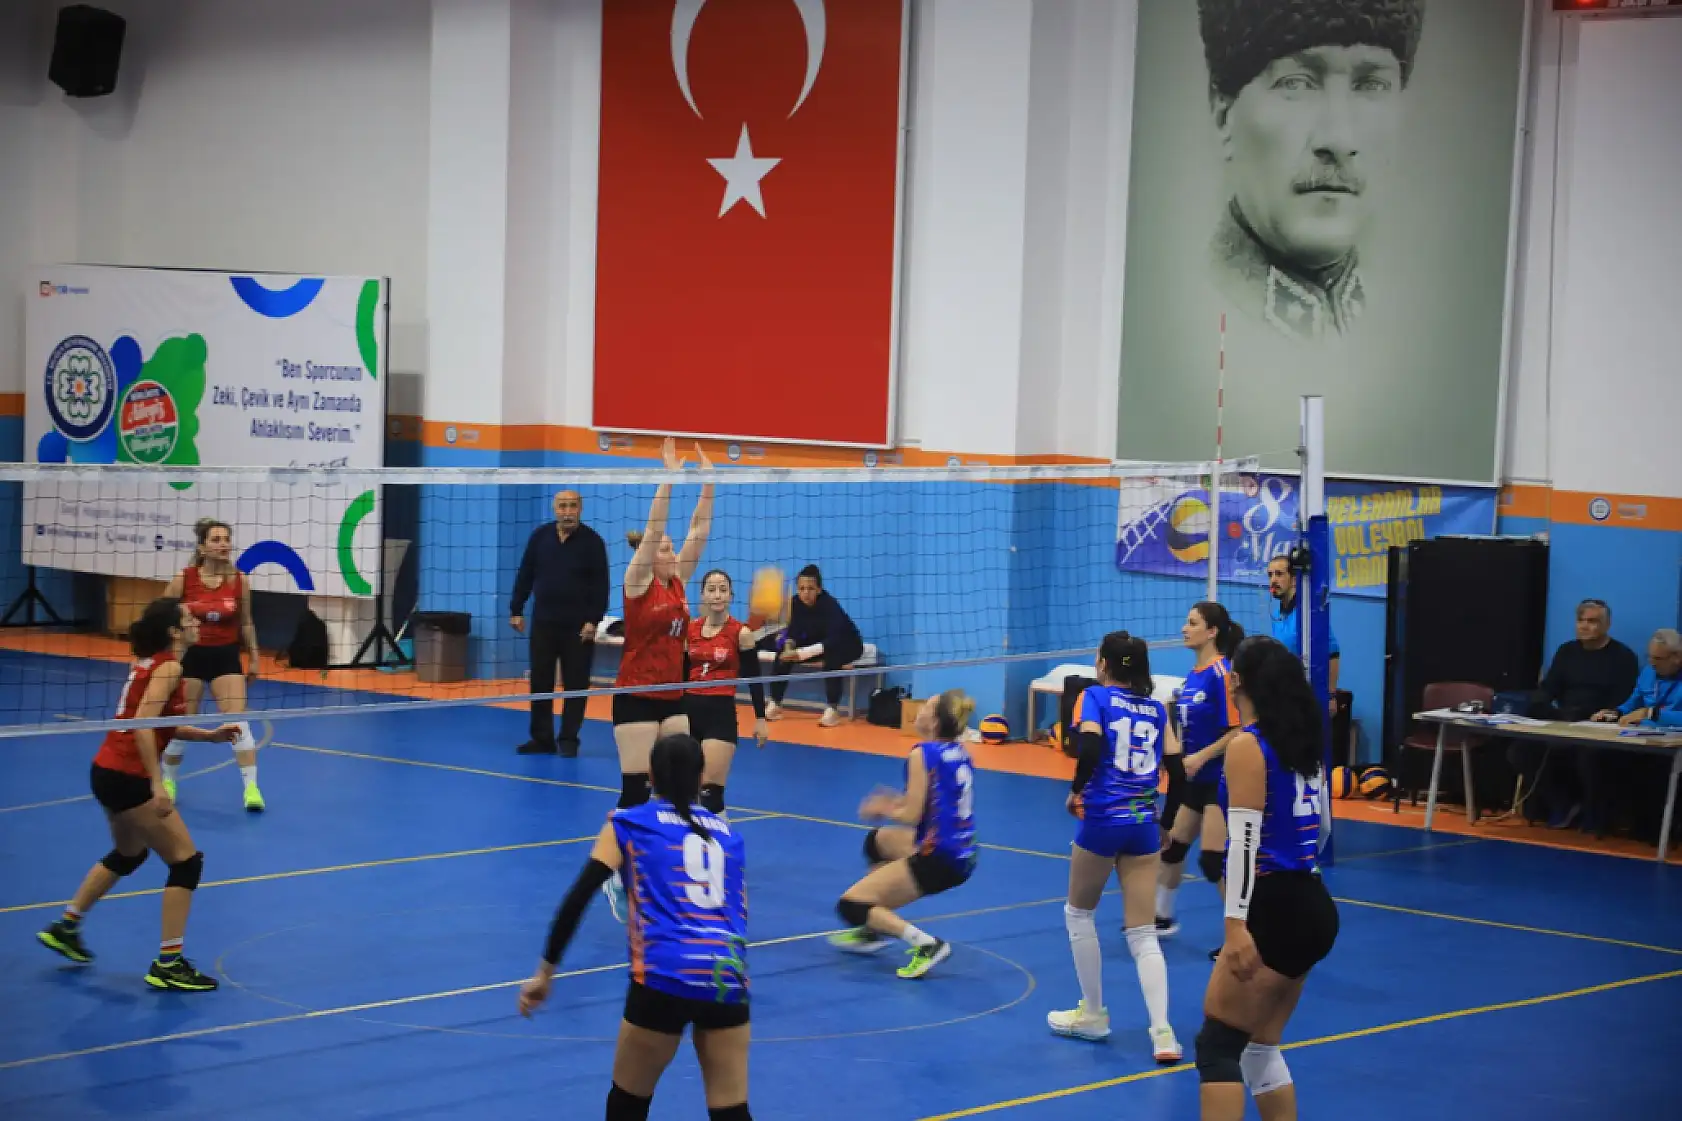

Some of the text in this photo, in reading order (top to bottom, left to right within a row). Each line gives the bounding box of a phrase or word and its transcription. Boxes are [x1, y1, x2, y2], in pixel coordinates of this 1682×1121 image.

[306, 360, 363, 384] Sporcunun
[212, 385, 238, 407] Zeki,
[241, 386, 270, 411] Çevik
[272, 393, 284, 408] ve
[313, 391, 361, 412] Zamanda
[1108, 717, 1160, 775] 13
[683, 833, 726, 909] 9
